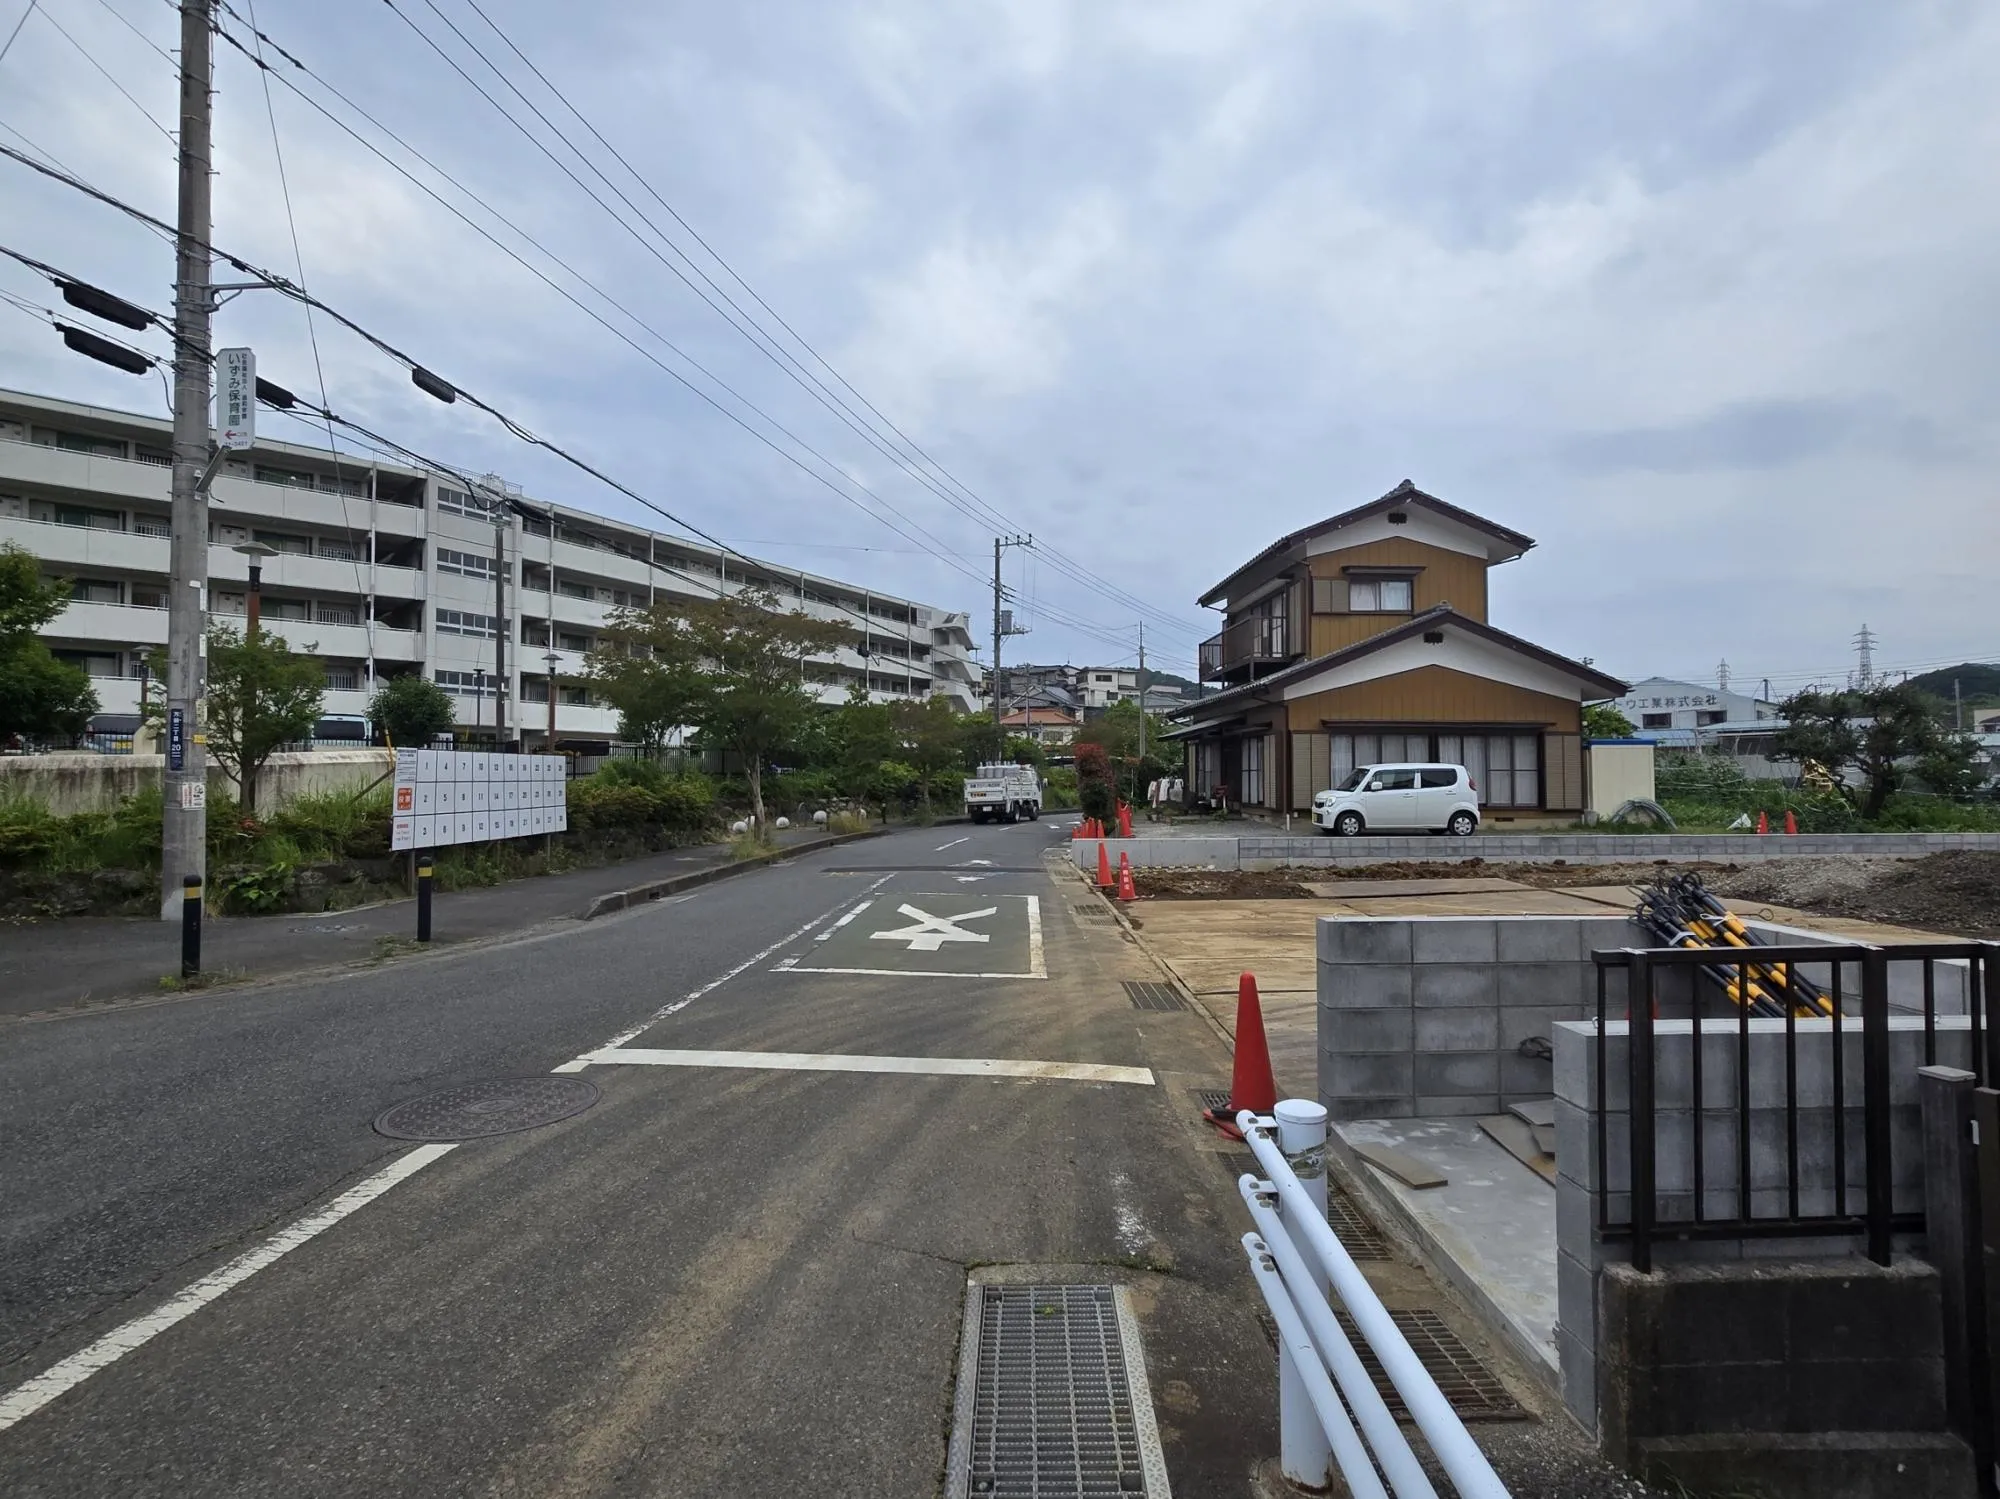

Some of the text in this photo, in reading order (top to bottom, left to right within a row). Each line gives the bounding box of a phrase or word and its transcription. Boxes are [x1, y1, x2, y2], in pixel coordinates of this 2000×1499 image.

[228, 353, 240, 426] いずみ保育園
